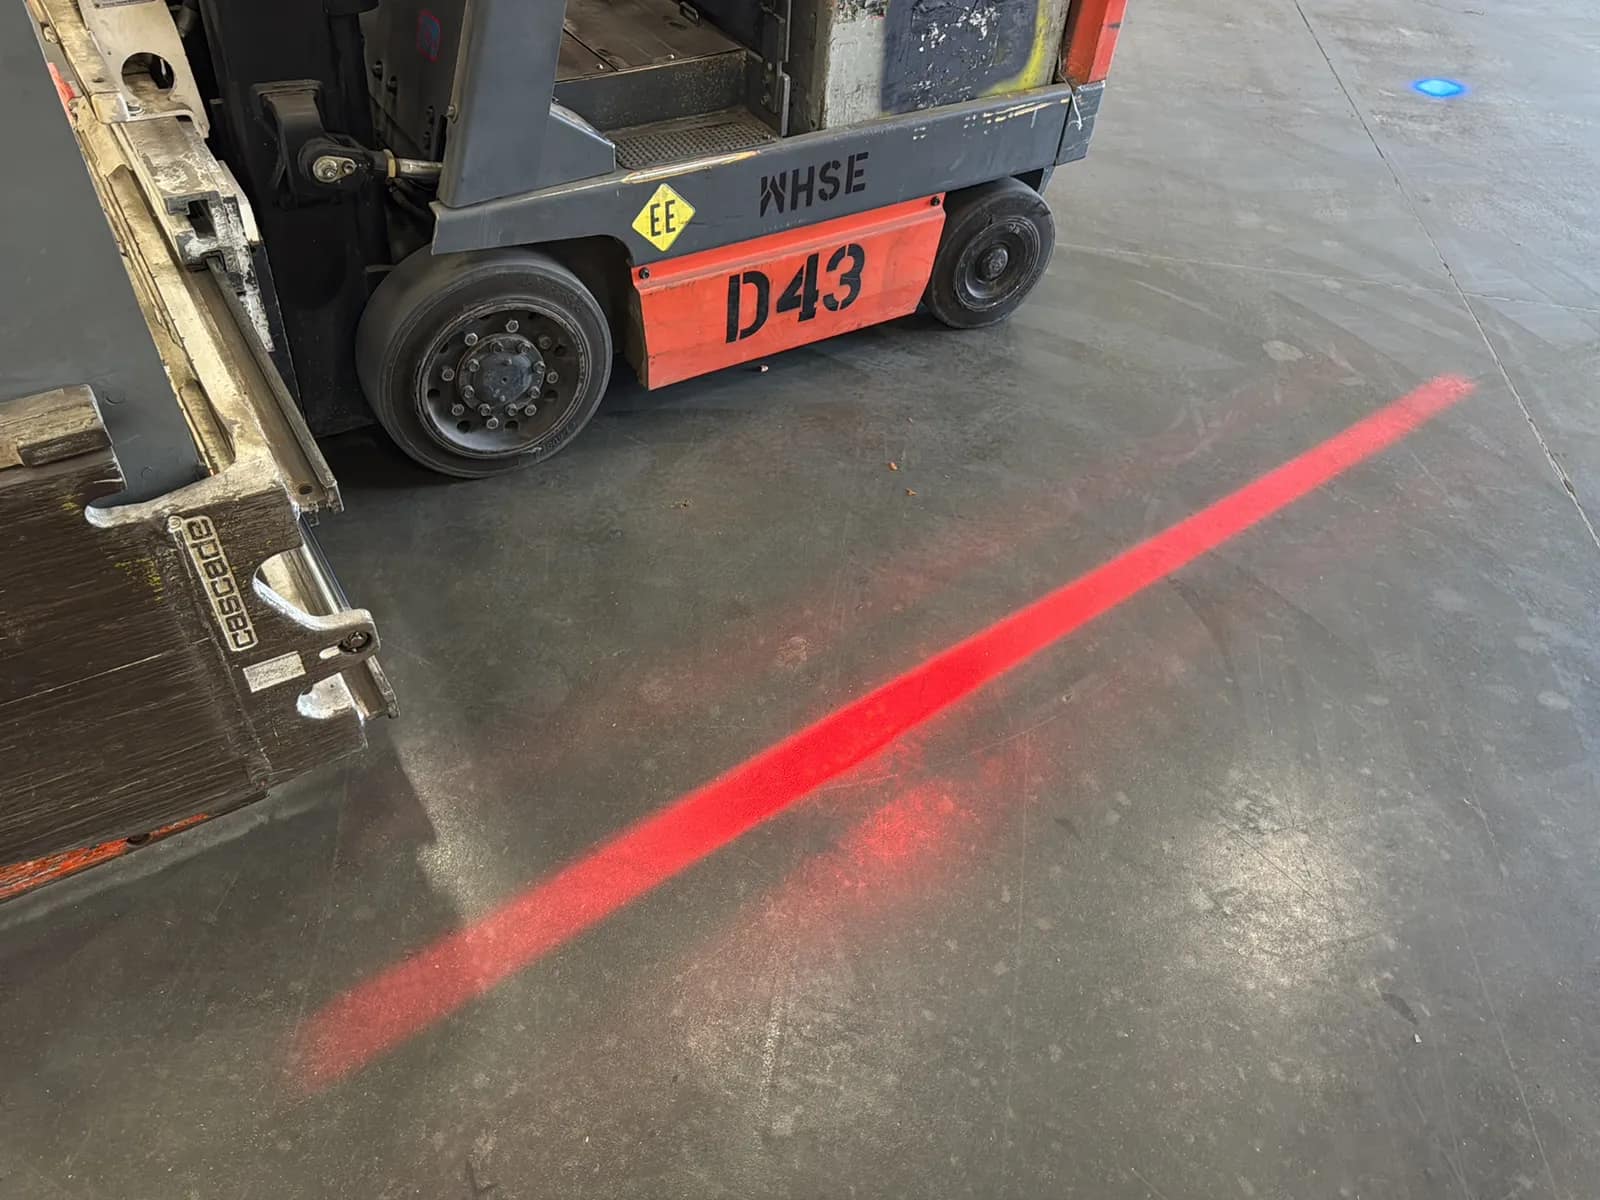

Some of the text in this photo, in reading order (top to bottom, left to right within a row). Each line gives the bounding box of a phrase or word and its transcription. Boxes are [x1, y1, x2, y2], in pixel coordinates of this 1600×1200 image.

[650, 200, 676, 236] EE
[760, 152, 869, 218] WHSE
[726, 243, 865, 343] D43
